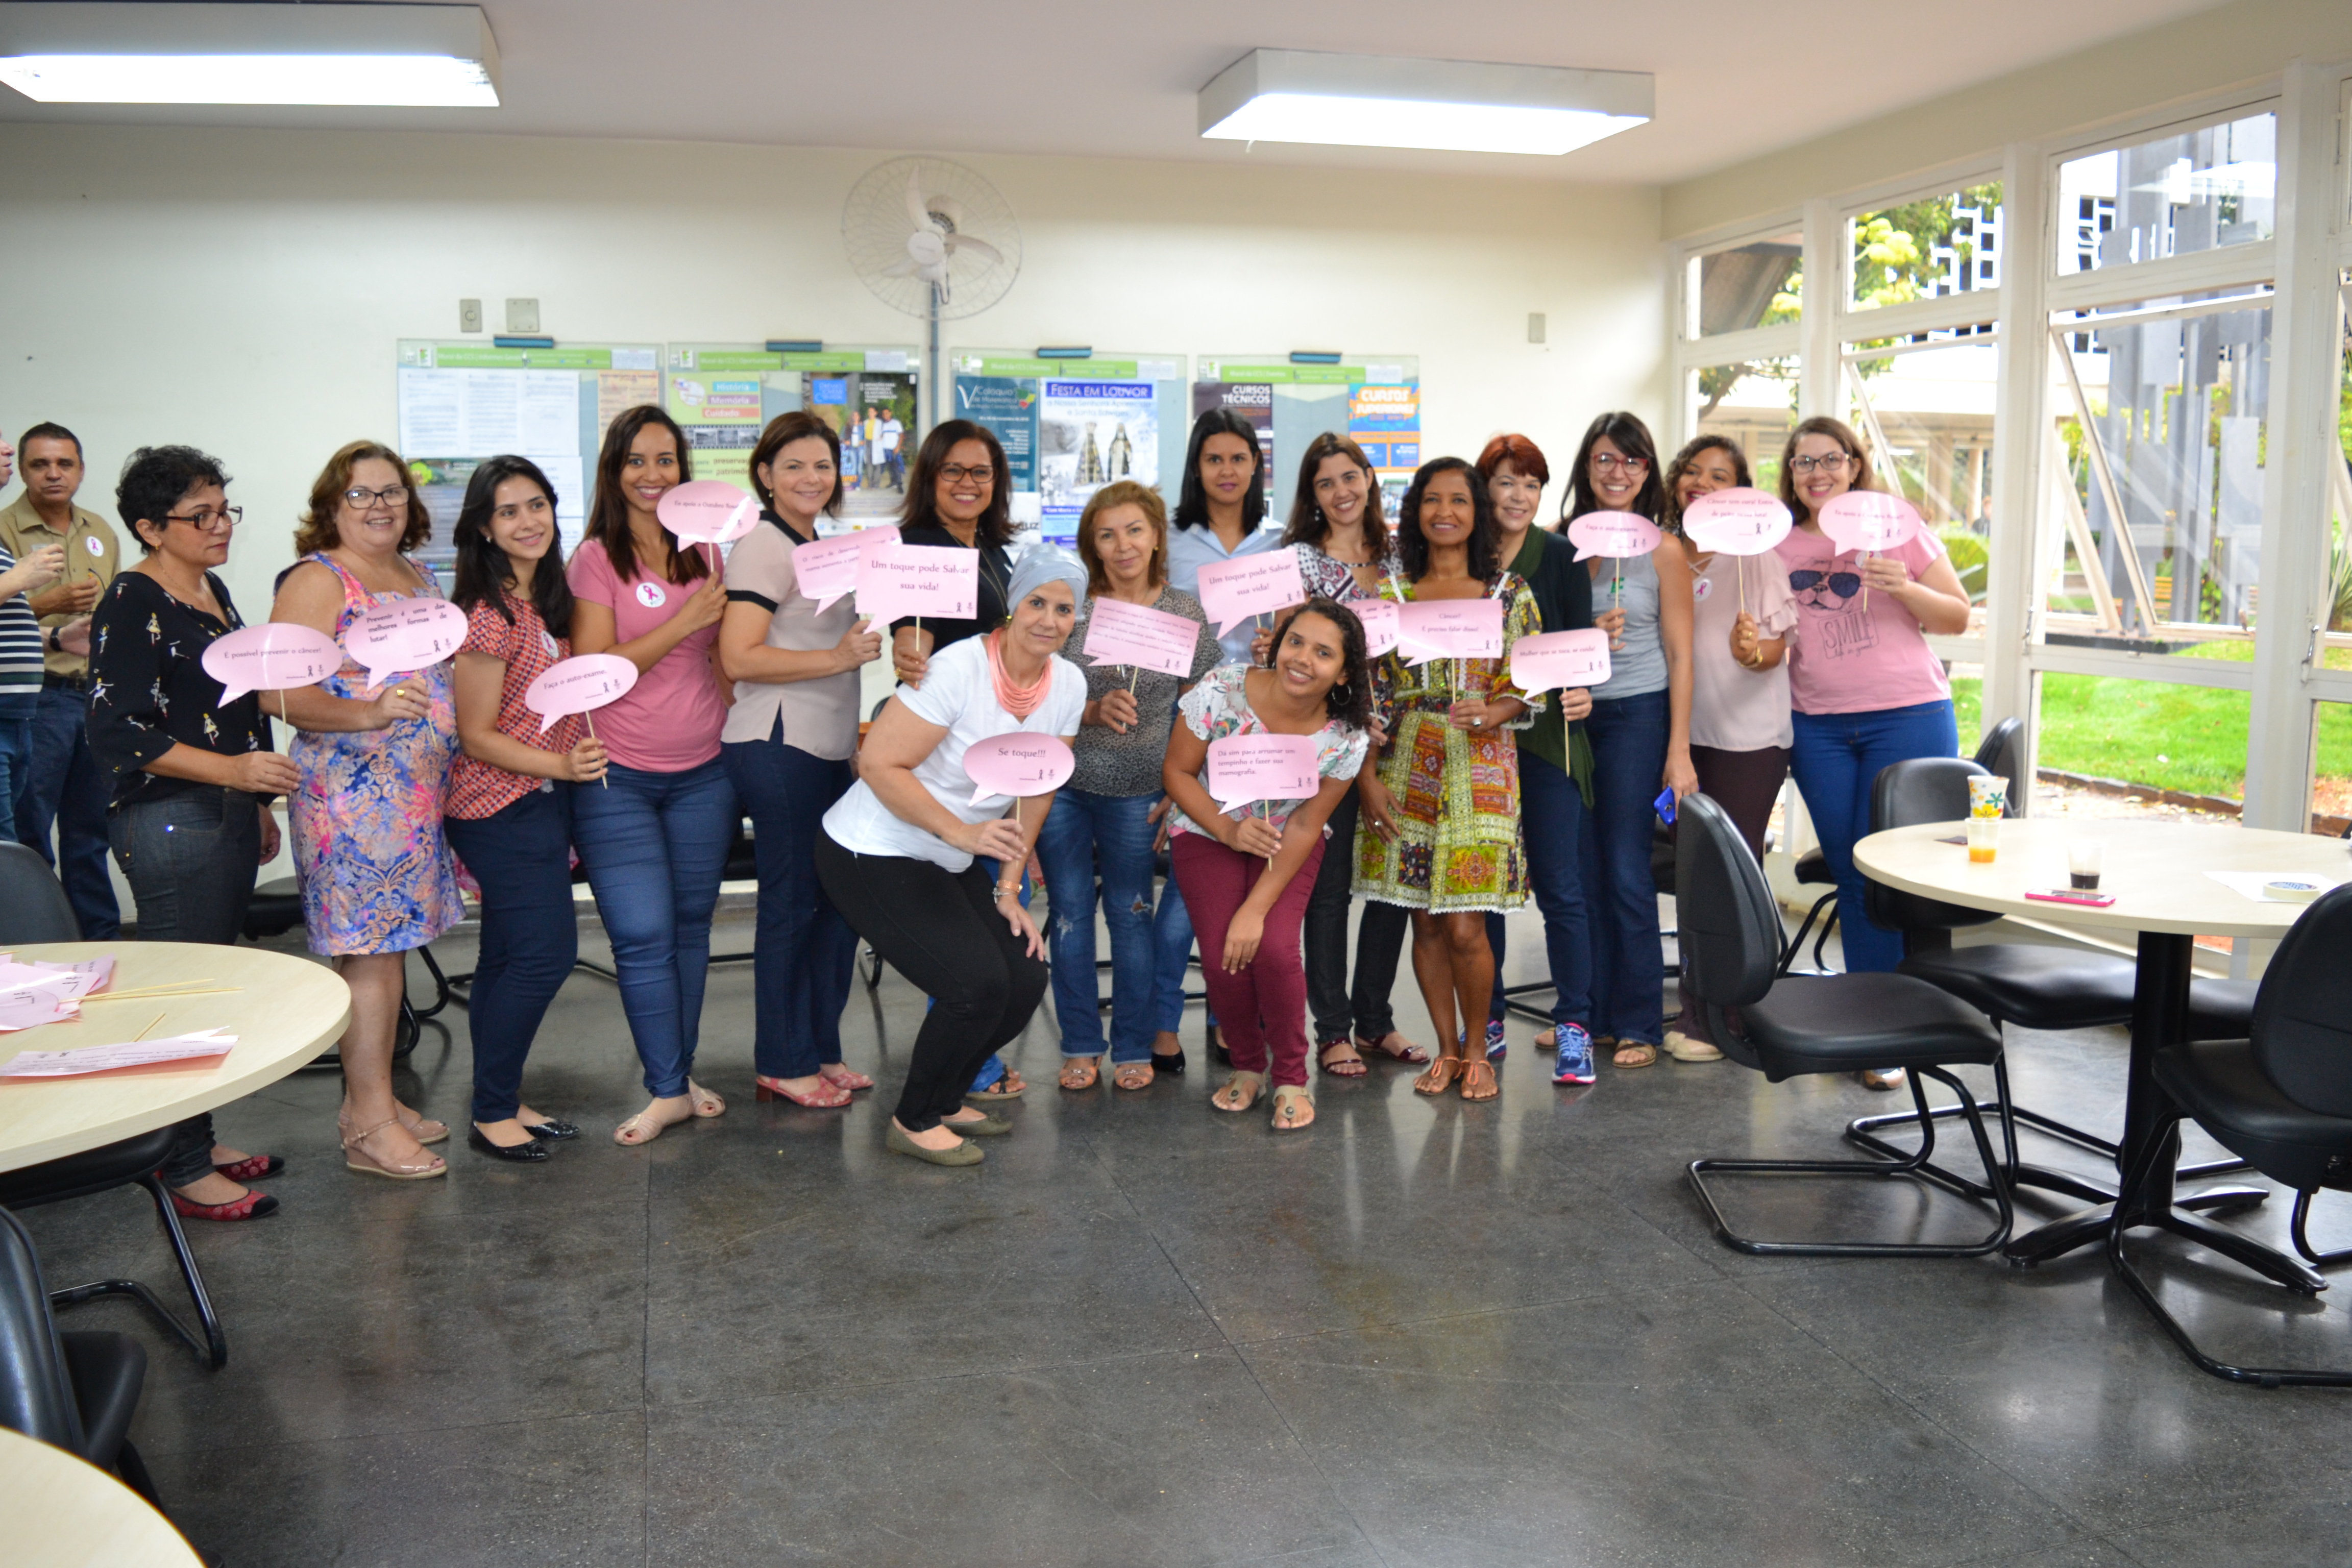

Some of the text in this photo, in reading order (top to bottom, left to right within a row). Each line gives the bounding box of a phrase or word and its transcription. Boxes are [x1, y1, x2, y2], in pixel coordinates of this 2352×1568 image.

[1232, 385, 1270, 395] CURSOS
[1221, 391, 1270, 404] TÉCNICOS
[1361, 389, 1408, 402] CURSOS
[704, 409, 740, 417] Cuidado
[872, 560, 969, 573] Um toque pode Salvar
[1225, 573, 1246, 582] toque
[1249, 568, 1266, 579] pode
[1269, 564, 1291, 573] Salvar
[918, 582, 939, 591] vida!
[1252, 583, 1269, 592] vida!
[366, 614, 393, 623] Prevenir
[368, 623, 397, 632] melhores
[1825, 612, 1874, 649] SMILE
[370, 634, 387, 643] lutar!
[231, 650, 258, 659] possível
[567, 670, 607, 683] auto-exame.
[998, 748, 1045, 759] Se toque!!!
[1218, 758, 1247, 767] tempinho
[1218, 769, 1256, 777] mamografia.
